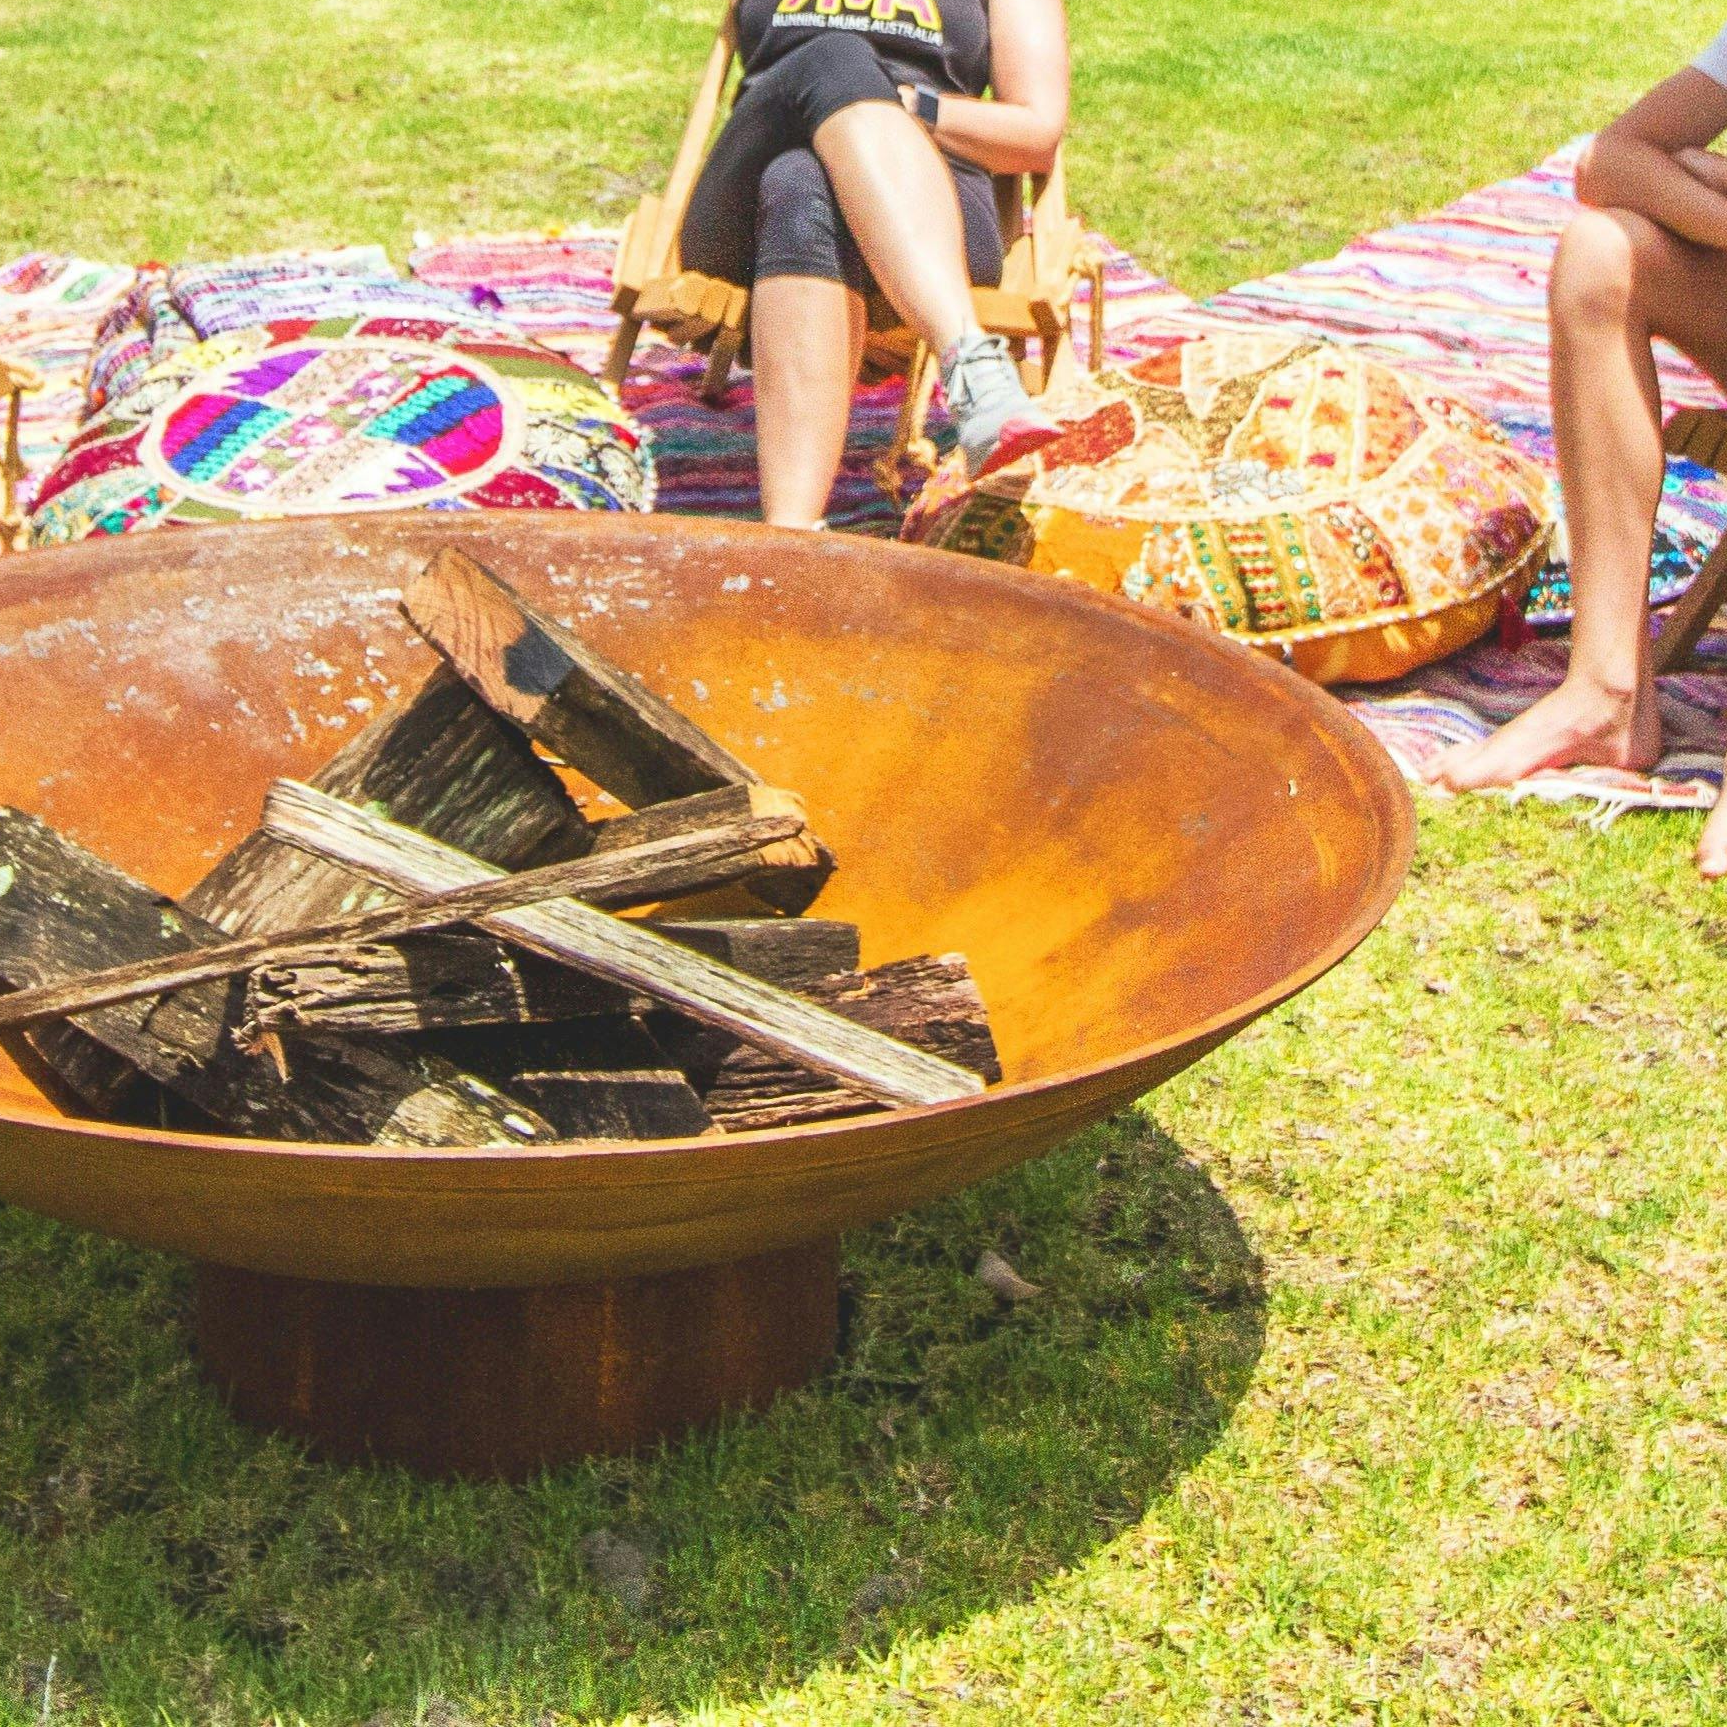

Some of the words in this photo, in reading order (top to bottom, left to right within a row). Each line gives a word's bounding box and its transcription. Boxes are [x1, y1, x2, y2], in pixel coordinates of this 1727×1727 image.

[772, 12, 826, 28] RUNNING
[828, 14, 870, 32] MUMS
[870, 20, 944, 47] AUSTRALIA
